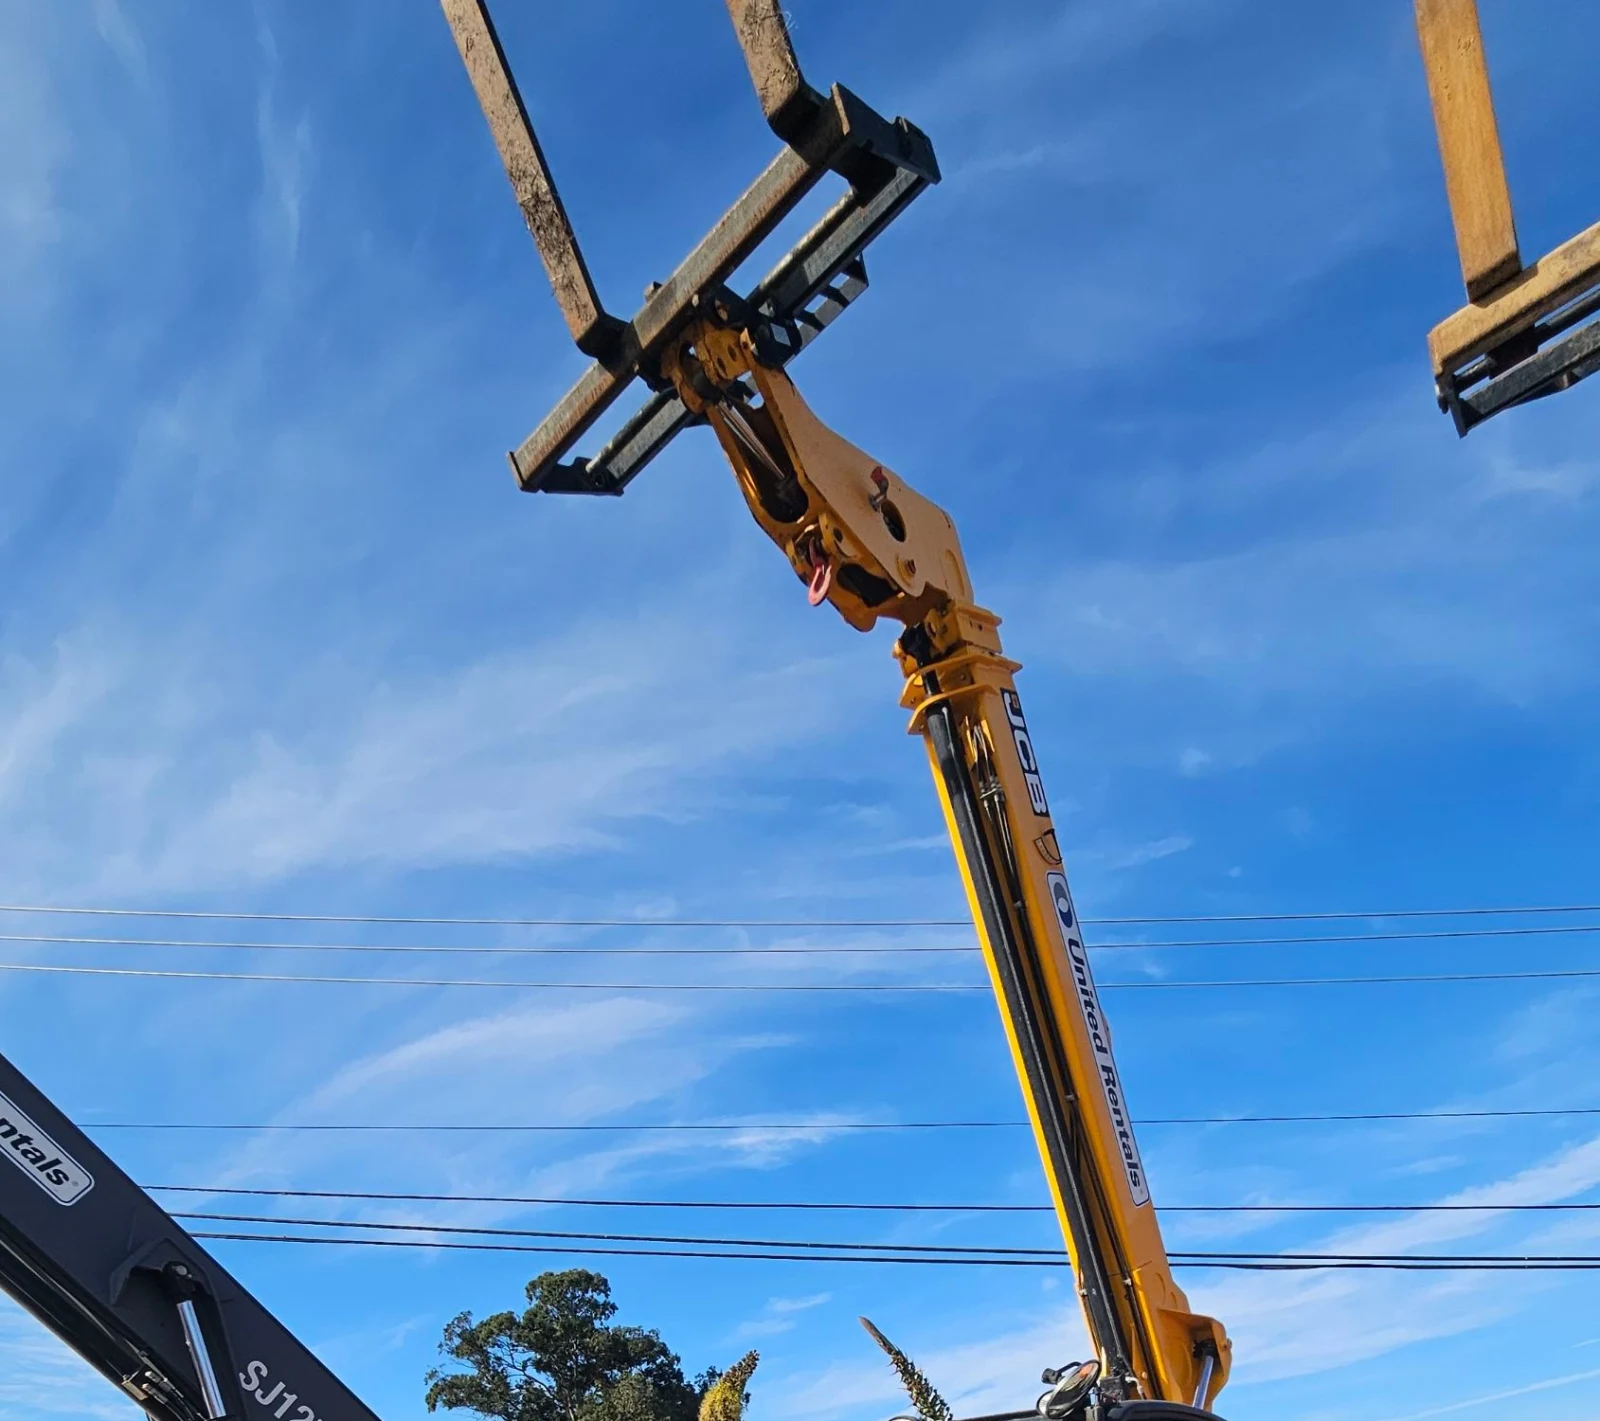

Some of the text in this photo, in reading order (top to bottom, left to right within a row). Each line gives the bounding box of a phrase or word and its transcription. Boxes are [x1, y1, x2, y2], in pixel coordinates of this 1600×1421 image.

[1003, 692, 1047, 814] JCB
[1068, 938, 1140, 1187] United Rentals
[0, 1117, 69, 1186] ntals
